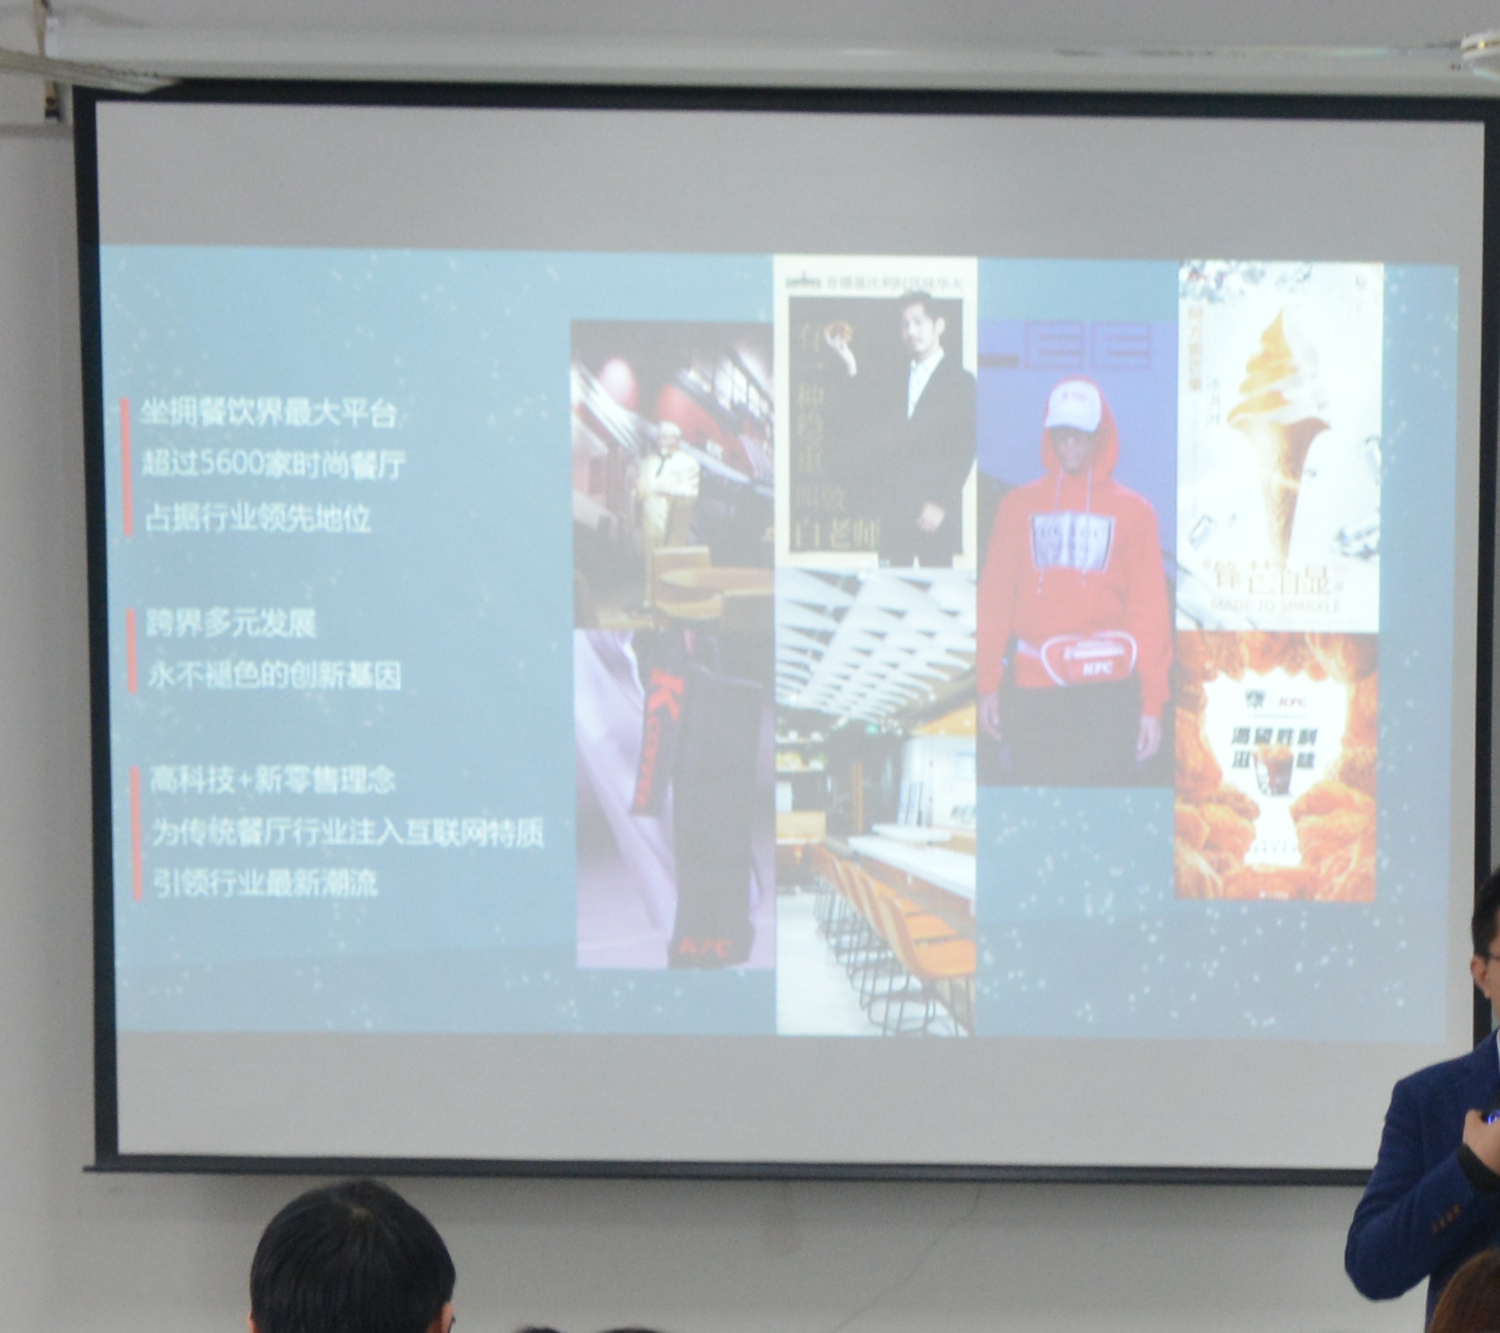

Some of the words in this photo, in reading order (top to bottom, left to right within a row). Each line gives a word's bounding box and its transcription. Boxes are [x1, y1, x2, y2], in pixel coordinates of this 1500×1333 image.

[140, 396, 397, 428] 坐拥餐饮界最大平台
[142, 448, 406, 480] 超过5600家时尚餐厅
[145, 502, 372, 533] 占据行业领先地位
[145, 607, 317, 639] 跨界多元发展
[148, 659, 402, 691] 永不褪色的创新基因
[150, 763, 396, 795] 高科技+新零售理念
[152, 816, 546, 849] 为传统餐厅行业注入互联网特质
[153, 868, 379, 899] 引领行业最新潮流
